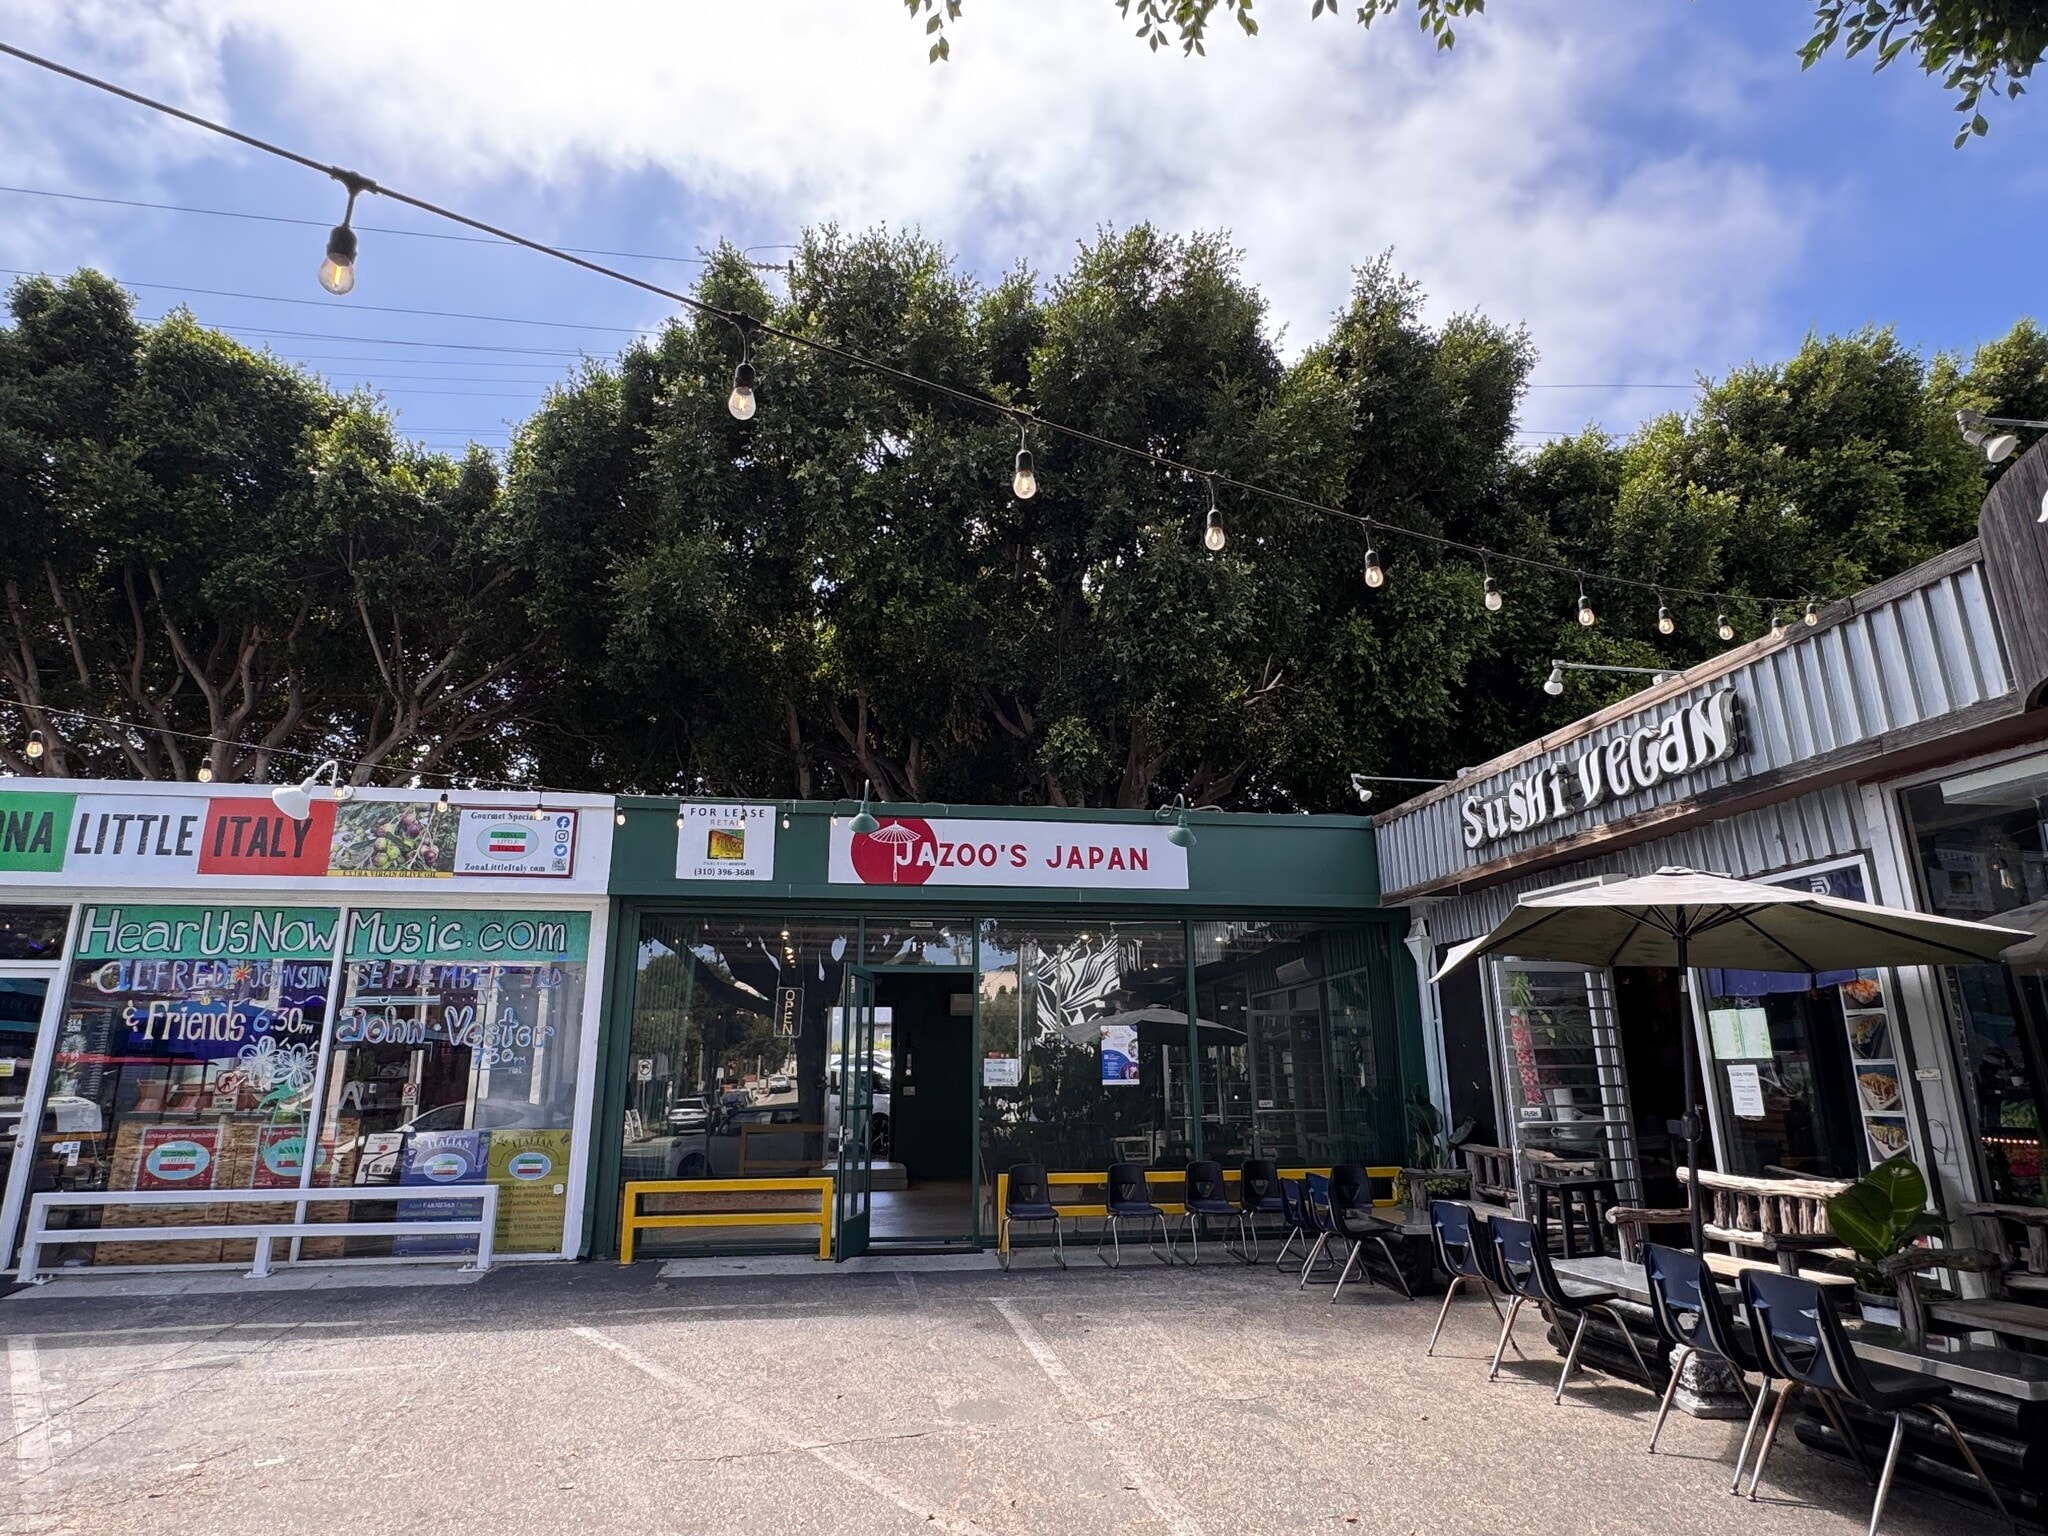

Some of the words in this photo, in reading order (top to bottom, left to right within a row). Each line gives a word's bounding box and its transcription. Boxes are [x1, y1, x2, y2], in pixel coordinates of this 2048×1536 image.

[471, 811, 505, 821] Gourmet
[690, 807, 717, 817] FOR
[724, 808, 766, 818] LEASE
[0, 811, 54, 854] NA
[74, 812, 198, 856] LITTLE
[213, 815, 313, 858] ITALY
[896, 840, 1028, 868] JAZOO'S
[1045, 845, 1150, 871] JAPAN
[464, 863, 546, 874] ZonaLittleItaly.com
[694, 868, 715, 877] (310)
[717, 868, 755, 876] 396-3688
[78, 907, 339, 955] HearUsNow
[347, 911, 568, 955] Music.com
[143, 999, 247, 1041] Friends
[782, 989, 796, 1036] OPEN
[336, 1006, 425, 1045] John
[427, 1137, 471, 1149] ITALIAN
[512, 1137, 553, 1147] ITALIAN
